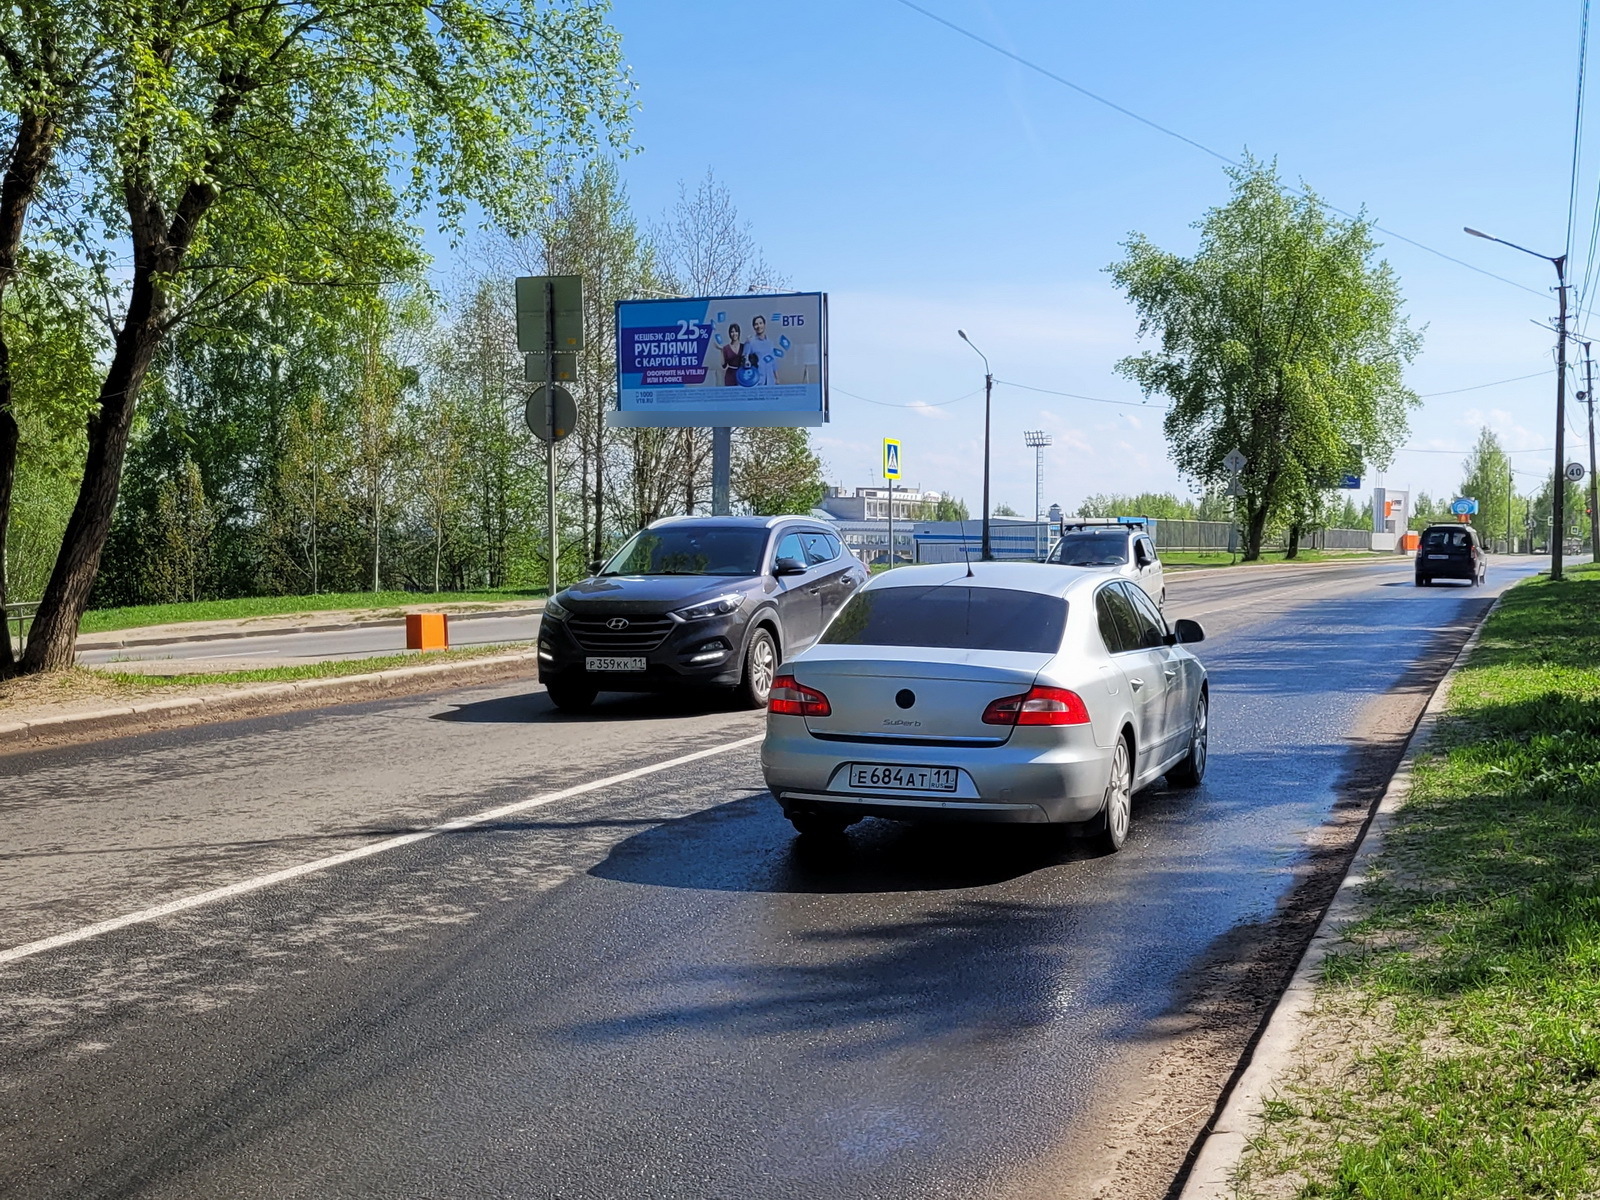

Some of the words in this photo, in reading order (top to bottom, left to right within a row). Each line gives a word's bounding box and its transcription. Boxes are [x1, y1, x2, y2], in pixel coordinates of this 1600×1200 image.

[782, 315, 805, 327] ВТБ
[634, 333, 664, 341] КЕШБЭК
[665, 332, 676, 341] ДО
[634, 341, 698, 356] РУБЛЯМИ
[643, 355, 680, 367] КАРТОЙ
[681, 356, 699, 366] ВТБ
[1569, 468, 1582, 476] 40
